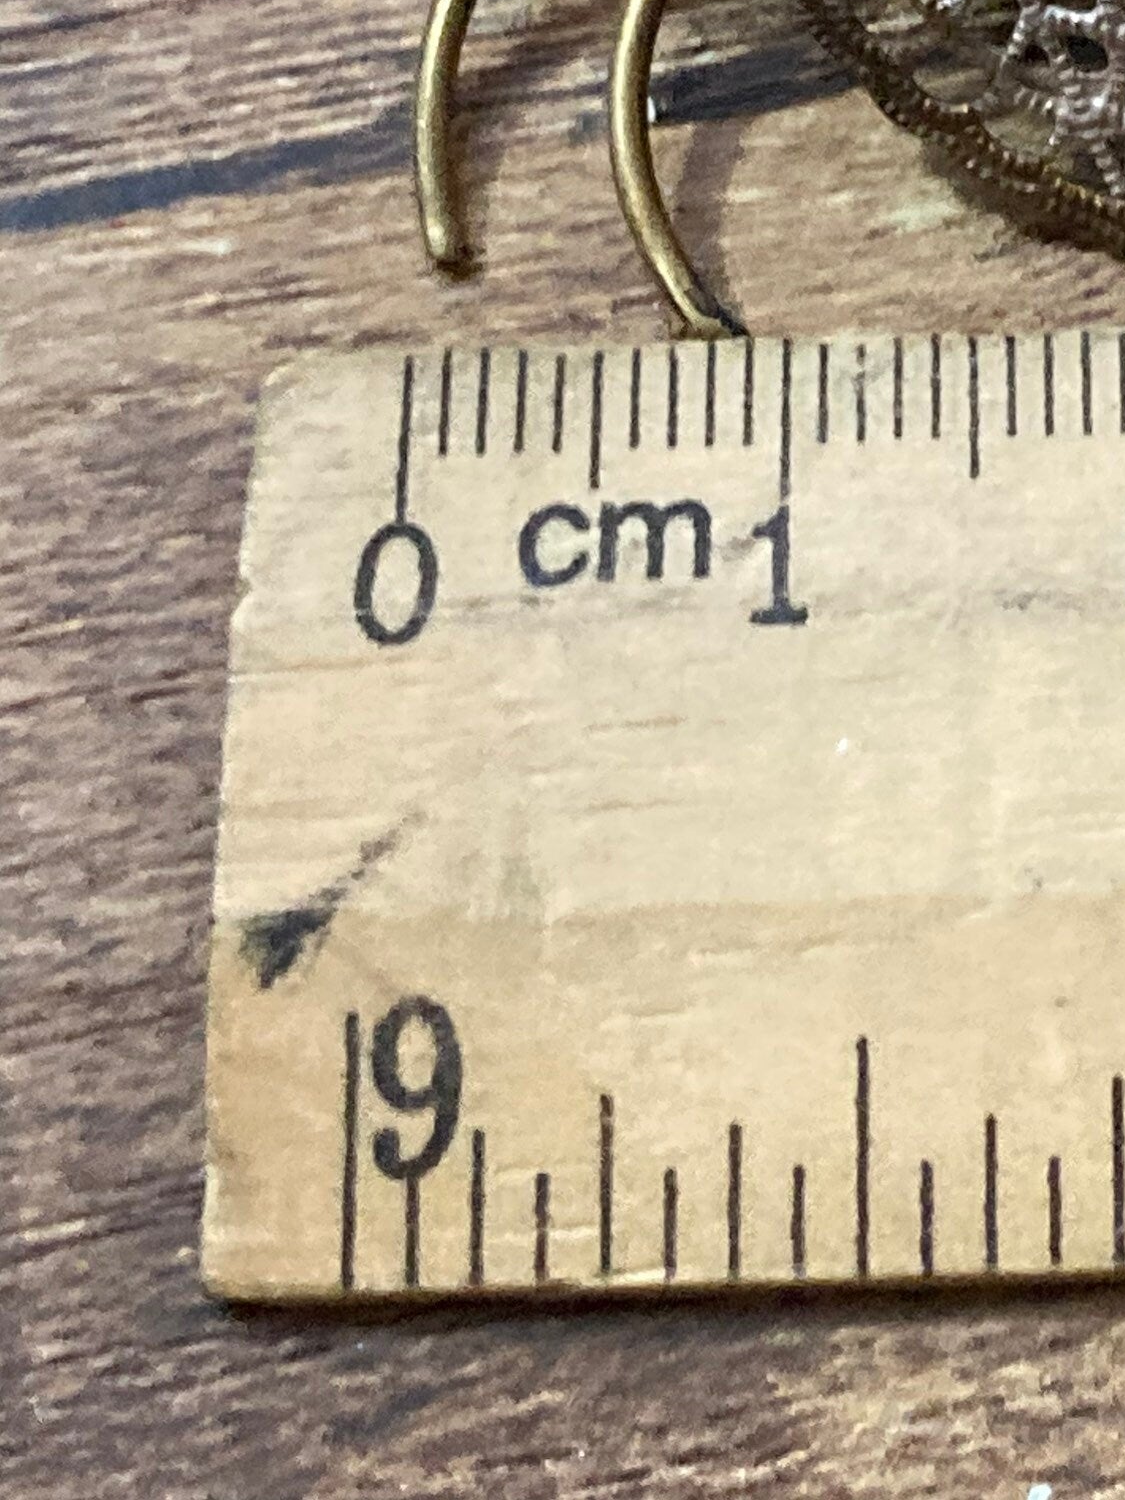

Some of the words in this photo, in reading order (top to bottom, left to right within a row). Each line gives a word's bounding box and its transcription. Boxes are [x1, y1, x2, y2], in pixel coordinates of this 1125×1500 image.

[354, 521, 440, 647] 0
[518, 498, 712, 587] cm
[749, 504, 809, 626] 1
